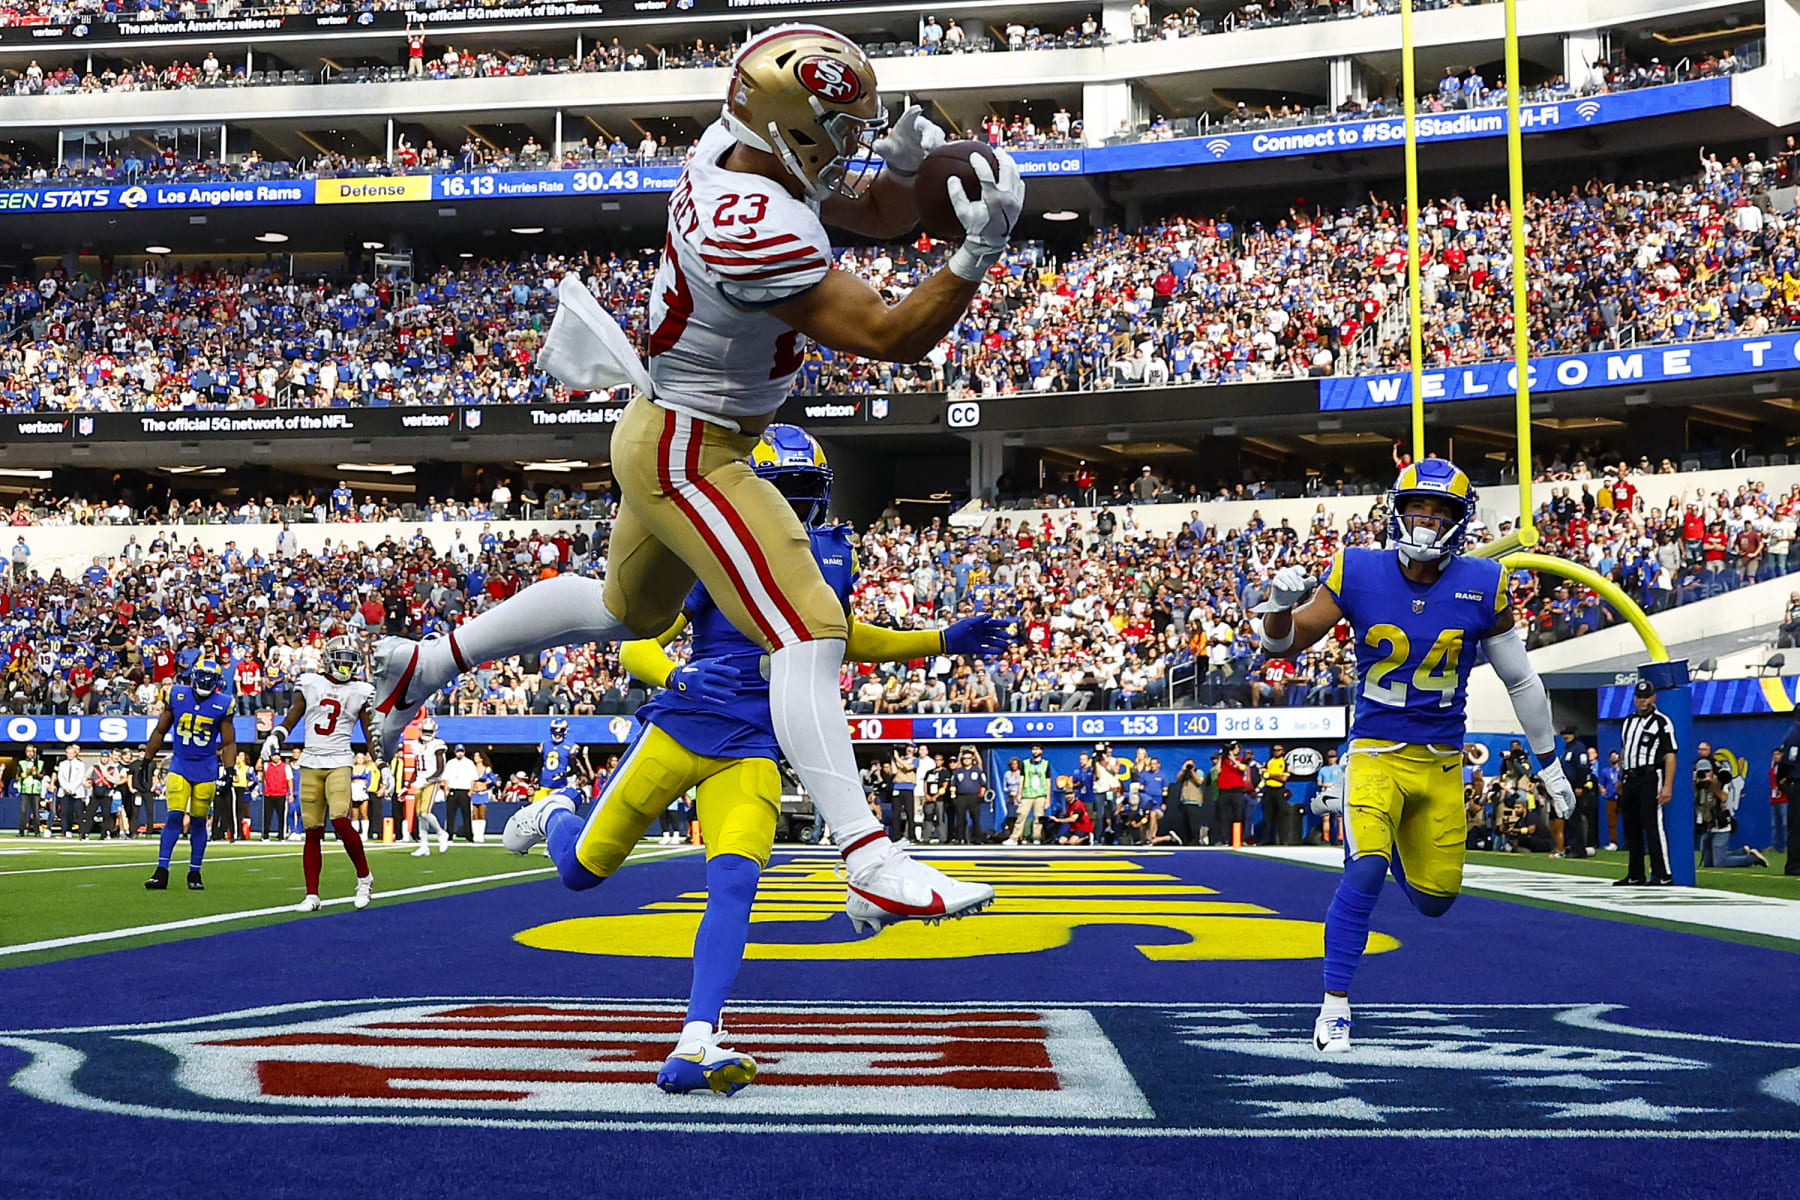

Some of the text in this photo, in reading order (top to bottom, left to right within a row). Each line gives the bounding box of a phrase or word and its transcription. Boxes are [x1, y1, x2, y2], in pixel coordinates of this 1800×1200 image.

[405, 3, 603, 23] The official 5G network of the Rams.
[118, 18, 281, 35] The network America relies on
[1252, 129, 1336, 153] Connect
[1337, 127, 1359, 144] to
[1361, 114, 1502, 143] #SoiStadium
[1048, 160, 1060, 172] to
[1061, 159, 1080, 171] QB
[340, 183, 406, 197] Defense
[441, 175, 494, 196] 16.13
[498, 182, 538, 194] Hurries
[539, 181, 565, 192] Rate
[573, 170, 639, 191] 30.43
[0, 189, 111, 209] GEN STATS
[158, 186, 302, 205] Los Angeles Rams
[712, 193, 769, 228] 23
[1367, 339, 1800, 403] WELCOME T
[530, 408, 624, 425] The official 5G
[805, 402, 855, 418] verizon
[951, 406, 976, 423] CC
[19, 420, 63, 433] verizon
[141, 414, 354, 432] The official 5G network of the NFL.
[402, 413, 450, 427] verizon
[822, 557, 843, 567] RAMS
[1454, 591, 1483, 602] RAMS
[41, 656, 51, 666] 19
[1362, 623, 1464, 709] 24
[1614, 672, 1638, 686] SoFi
[314, 698, 341, 736] 3
[1082, 715, 1159, 735] Q3 1:53
[1183, 716, 1211, 734] :40
[1224, 716, 1279, 732] 3rd & 3
[1323, 716, 1331, 731] 9
[176, 712, 215, 748] 45
[857, 719, 884, 740] 10
[932, 718, 958, 739] 14
[545, 750, 559, 771] 6
[1292, 753, 1314, 765] FOX
